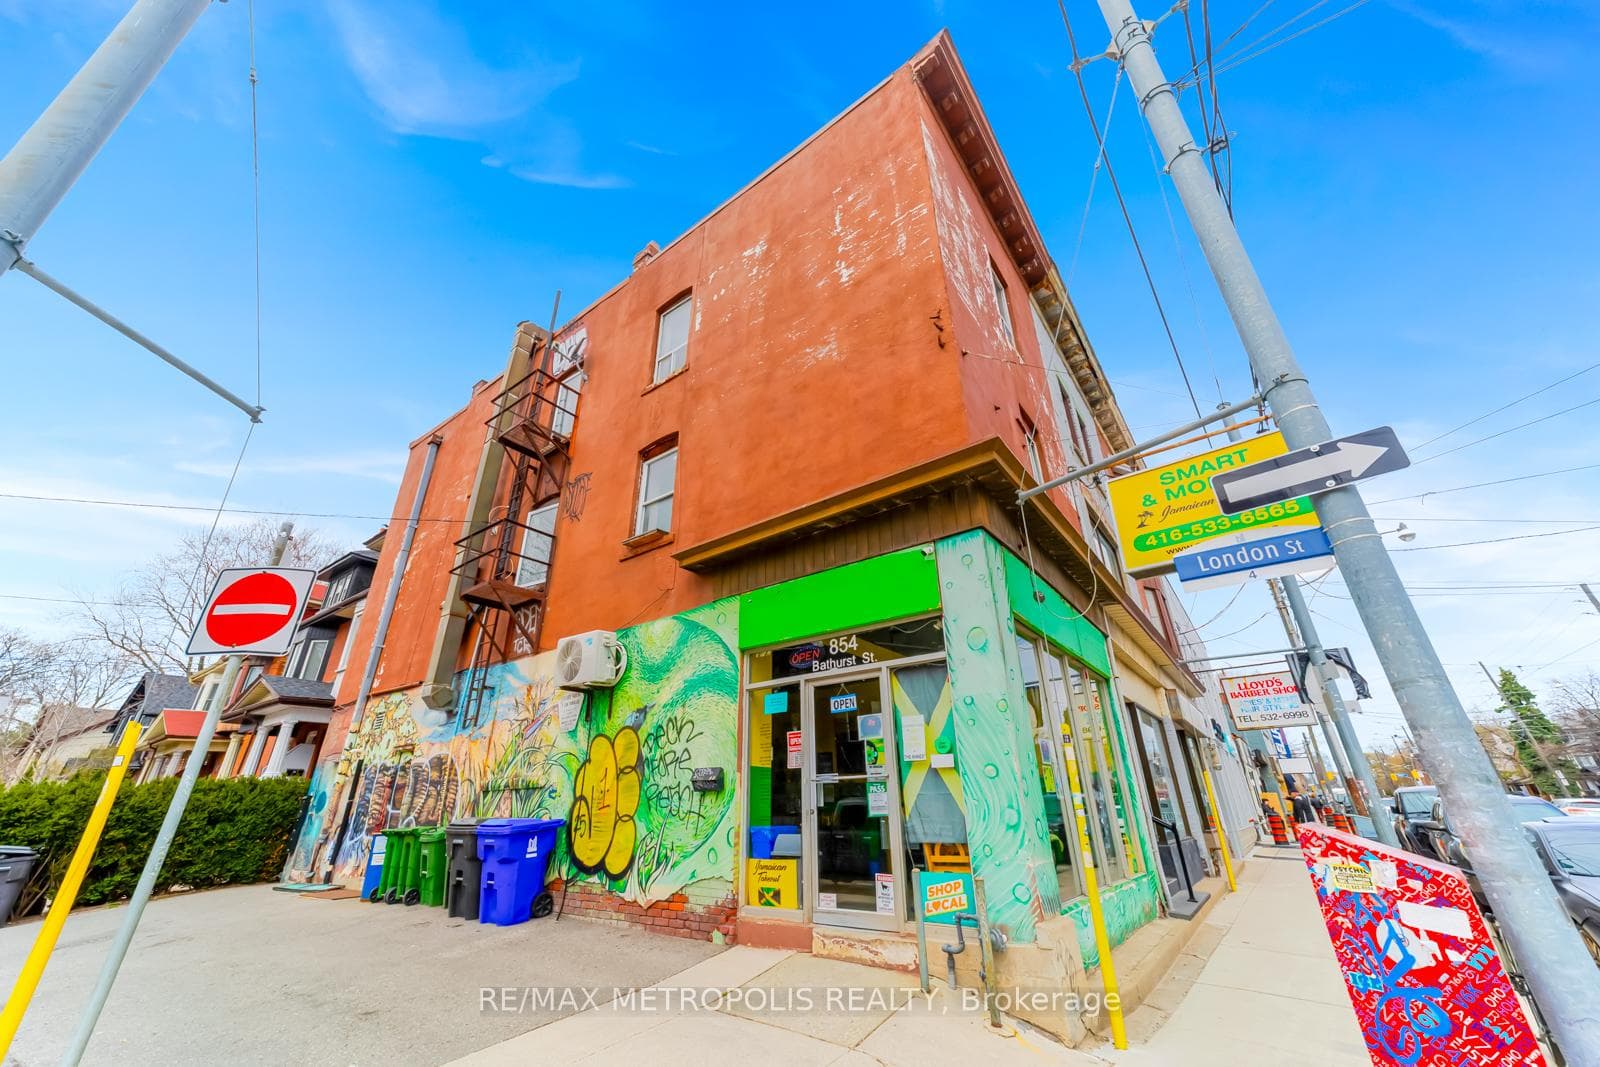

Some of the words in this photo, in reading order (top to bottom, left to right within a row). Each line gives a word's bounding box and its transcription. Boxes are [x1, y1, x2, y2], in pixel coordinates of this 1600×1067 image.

[1159, 448, 1249, 487] SMART
[1142, 494, 1157, 508] &
[1158, 498, 1214, 523] Jamaican
[1144, 500, 1300, 547] 416-533-6565
[1197, 543, 1279, 572] London
[1284, 540, 1305, 555] St
[829, 634, 858, 655] 854
[791, 648, 820, 664] OPEN
[812, 655, 857, 673] Bathurst
[862, 651, 878, 664] St.
[1237, 677, 1283, 691] LLOYD'S
[1230, 689, 1271, 699] BARBER
[833, 698, 856, 711] OPEN
[1237, 715, 1259, 723] TEL.
[1260, 710, 1310, 721] 532-6998
[869, 785, 886, 793] PASS
[753, 860, 787, 875] Jamaican
[928, 881, 962, 897] SHOP
